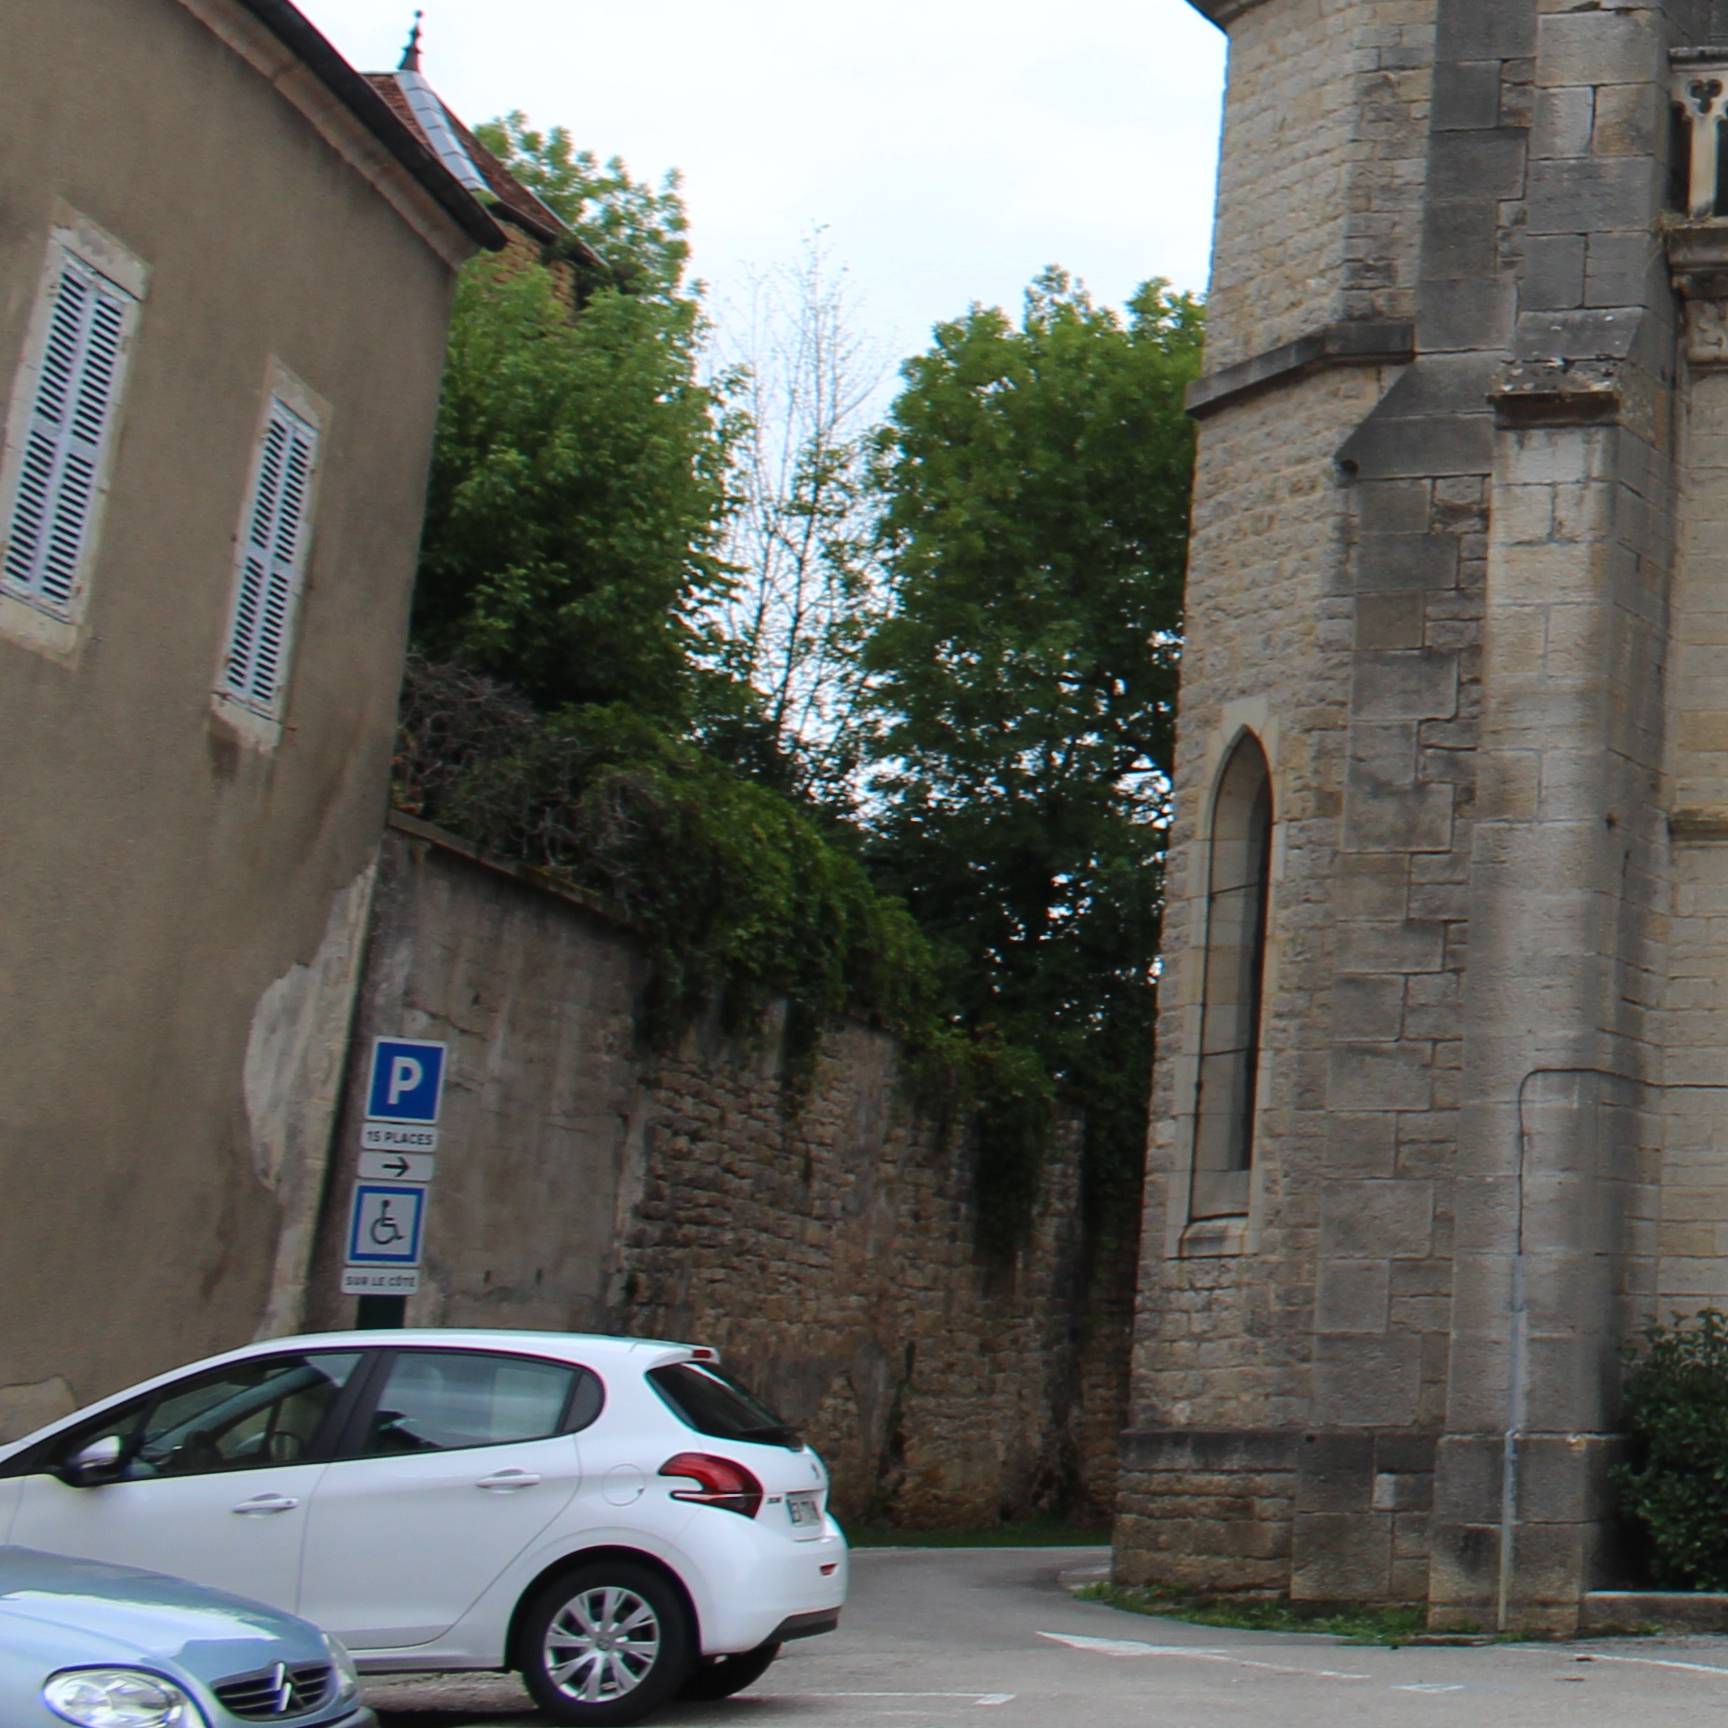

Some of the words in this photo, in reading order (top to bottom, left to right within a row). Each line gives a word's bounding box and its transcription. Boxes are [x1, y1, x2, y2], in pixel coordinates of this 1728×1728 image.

[387, 1055, 423, 1105] P
[367, 1130, 380, 1143] 15
[384, 1131, 433, 1146] PLACES
[345, 1275, 369, 1286] SUR
[371, 1275, 385, 1287] LE
